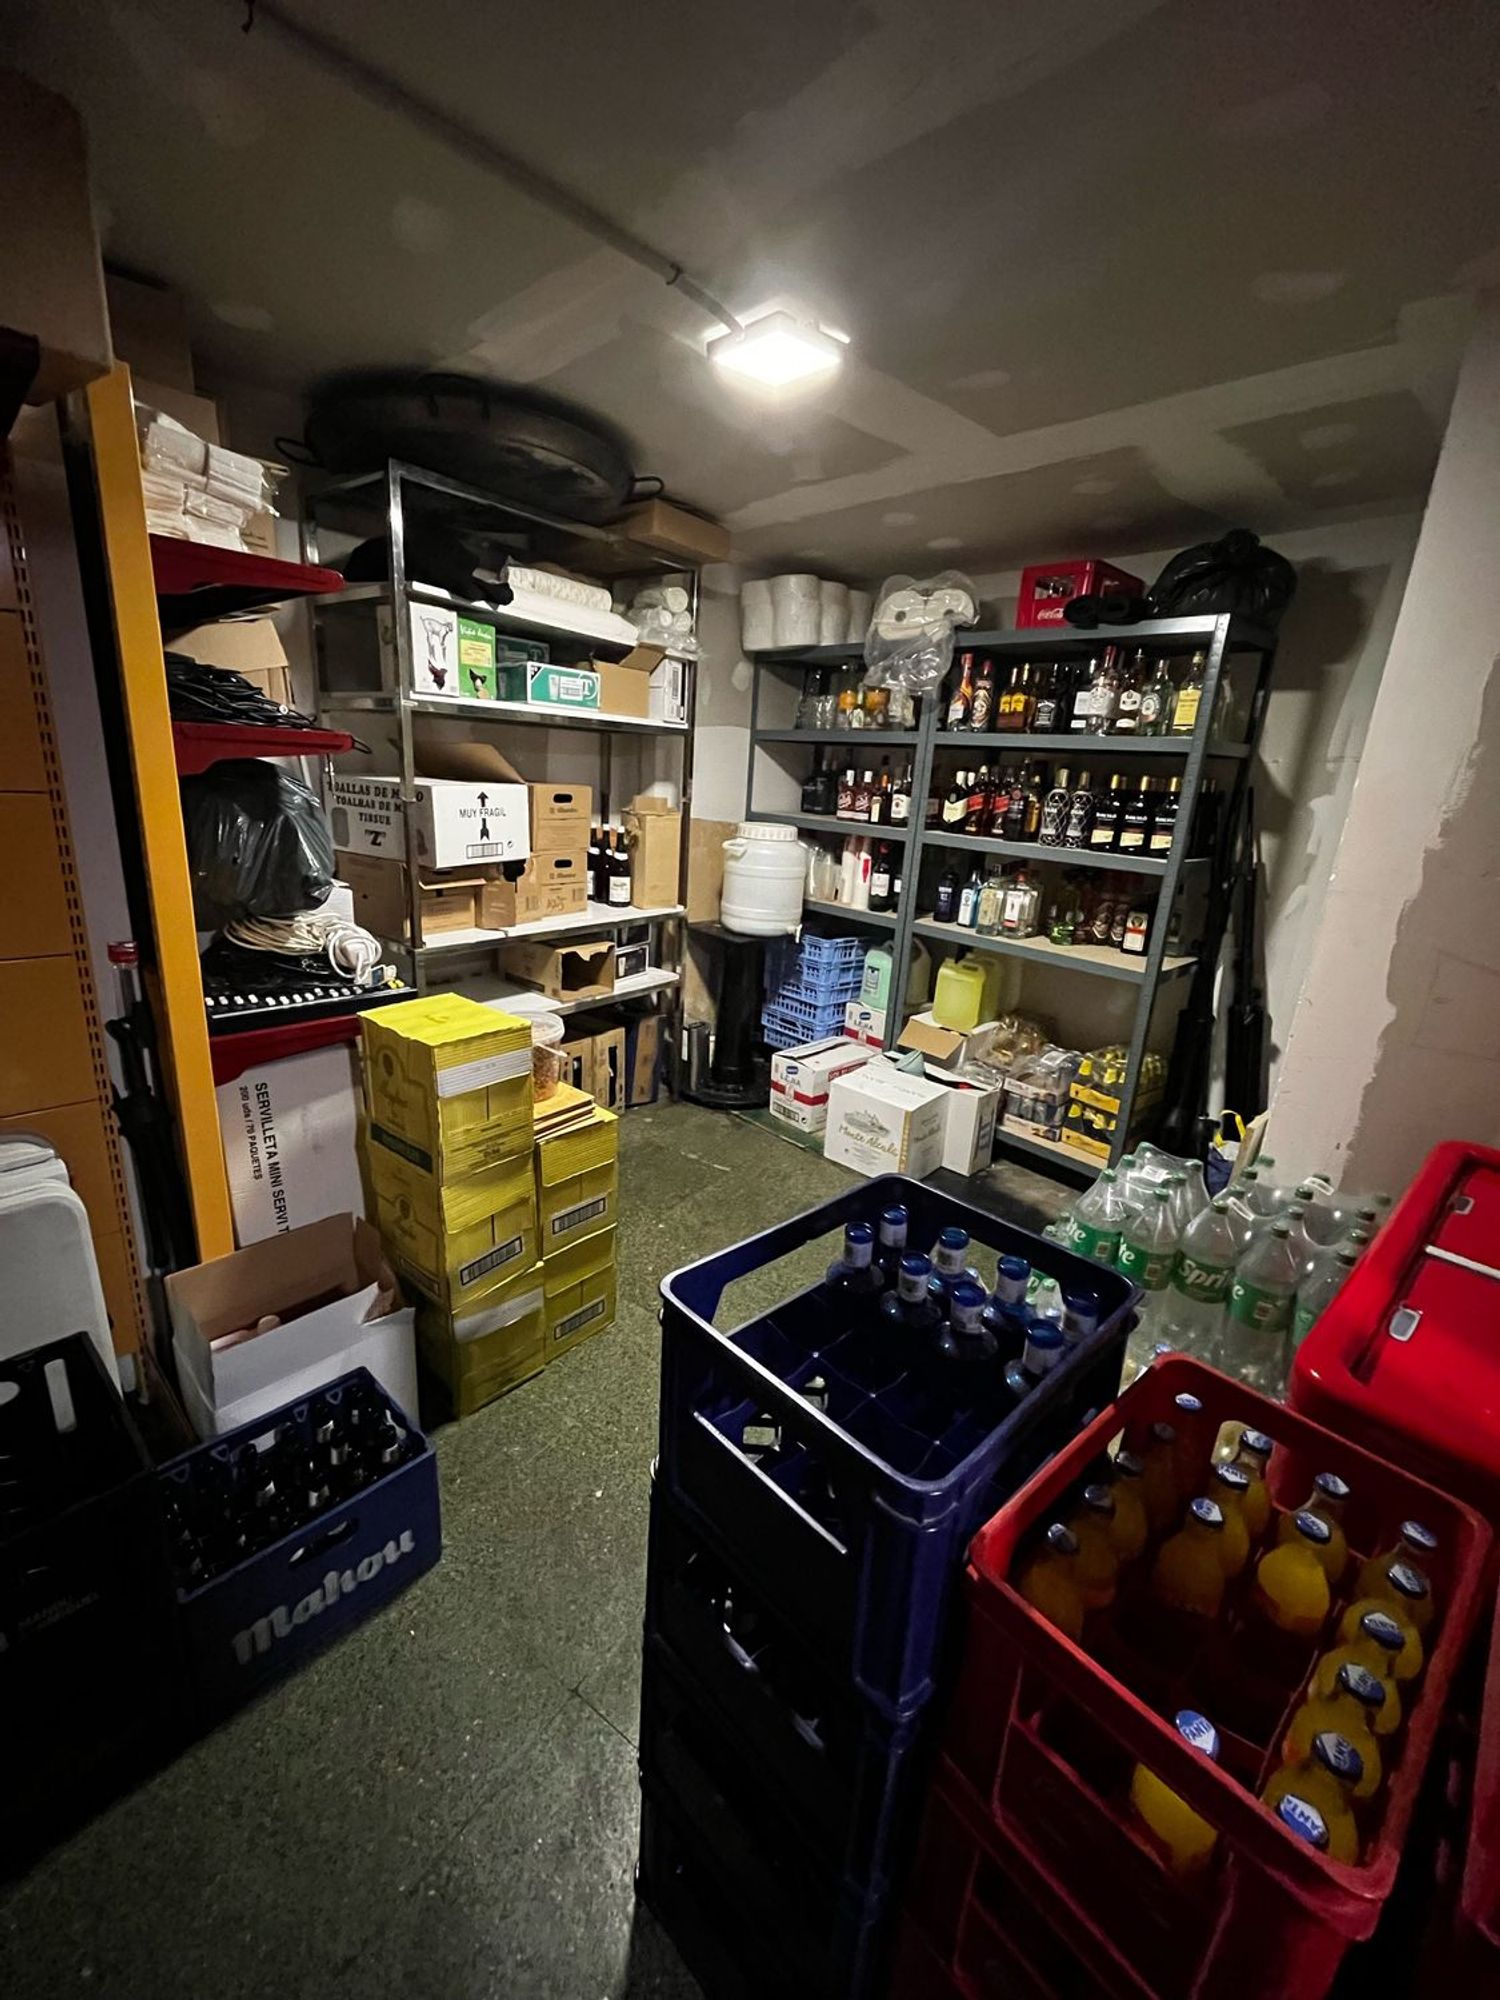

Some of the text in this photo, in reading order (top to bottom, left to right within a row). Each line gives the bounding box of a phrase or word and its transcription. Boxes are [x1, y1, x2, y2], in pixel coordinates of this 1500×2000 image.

[375, 786, 388, 798] DE
[379, 801, 390, 811] DE
[359, 812, 391, 825] TISSUE
[459, 808, 477, 818] MUY
[255, 1082, 278, 1160] SERVILLETA
[268, 1161, 283, 1188] MINI
[248, 1135, 263, 1180] PAQUETES
